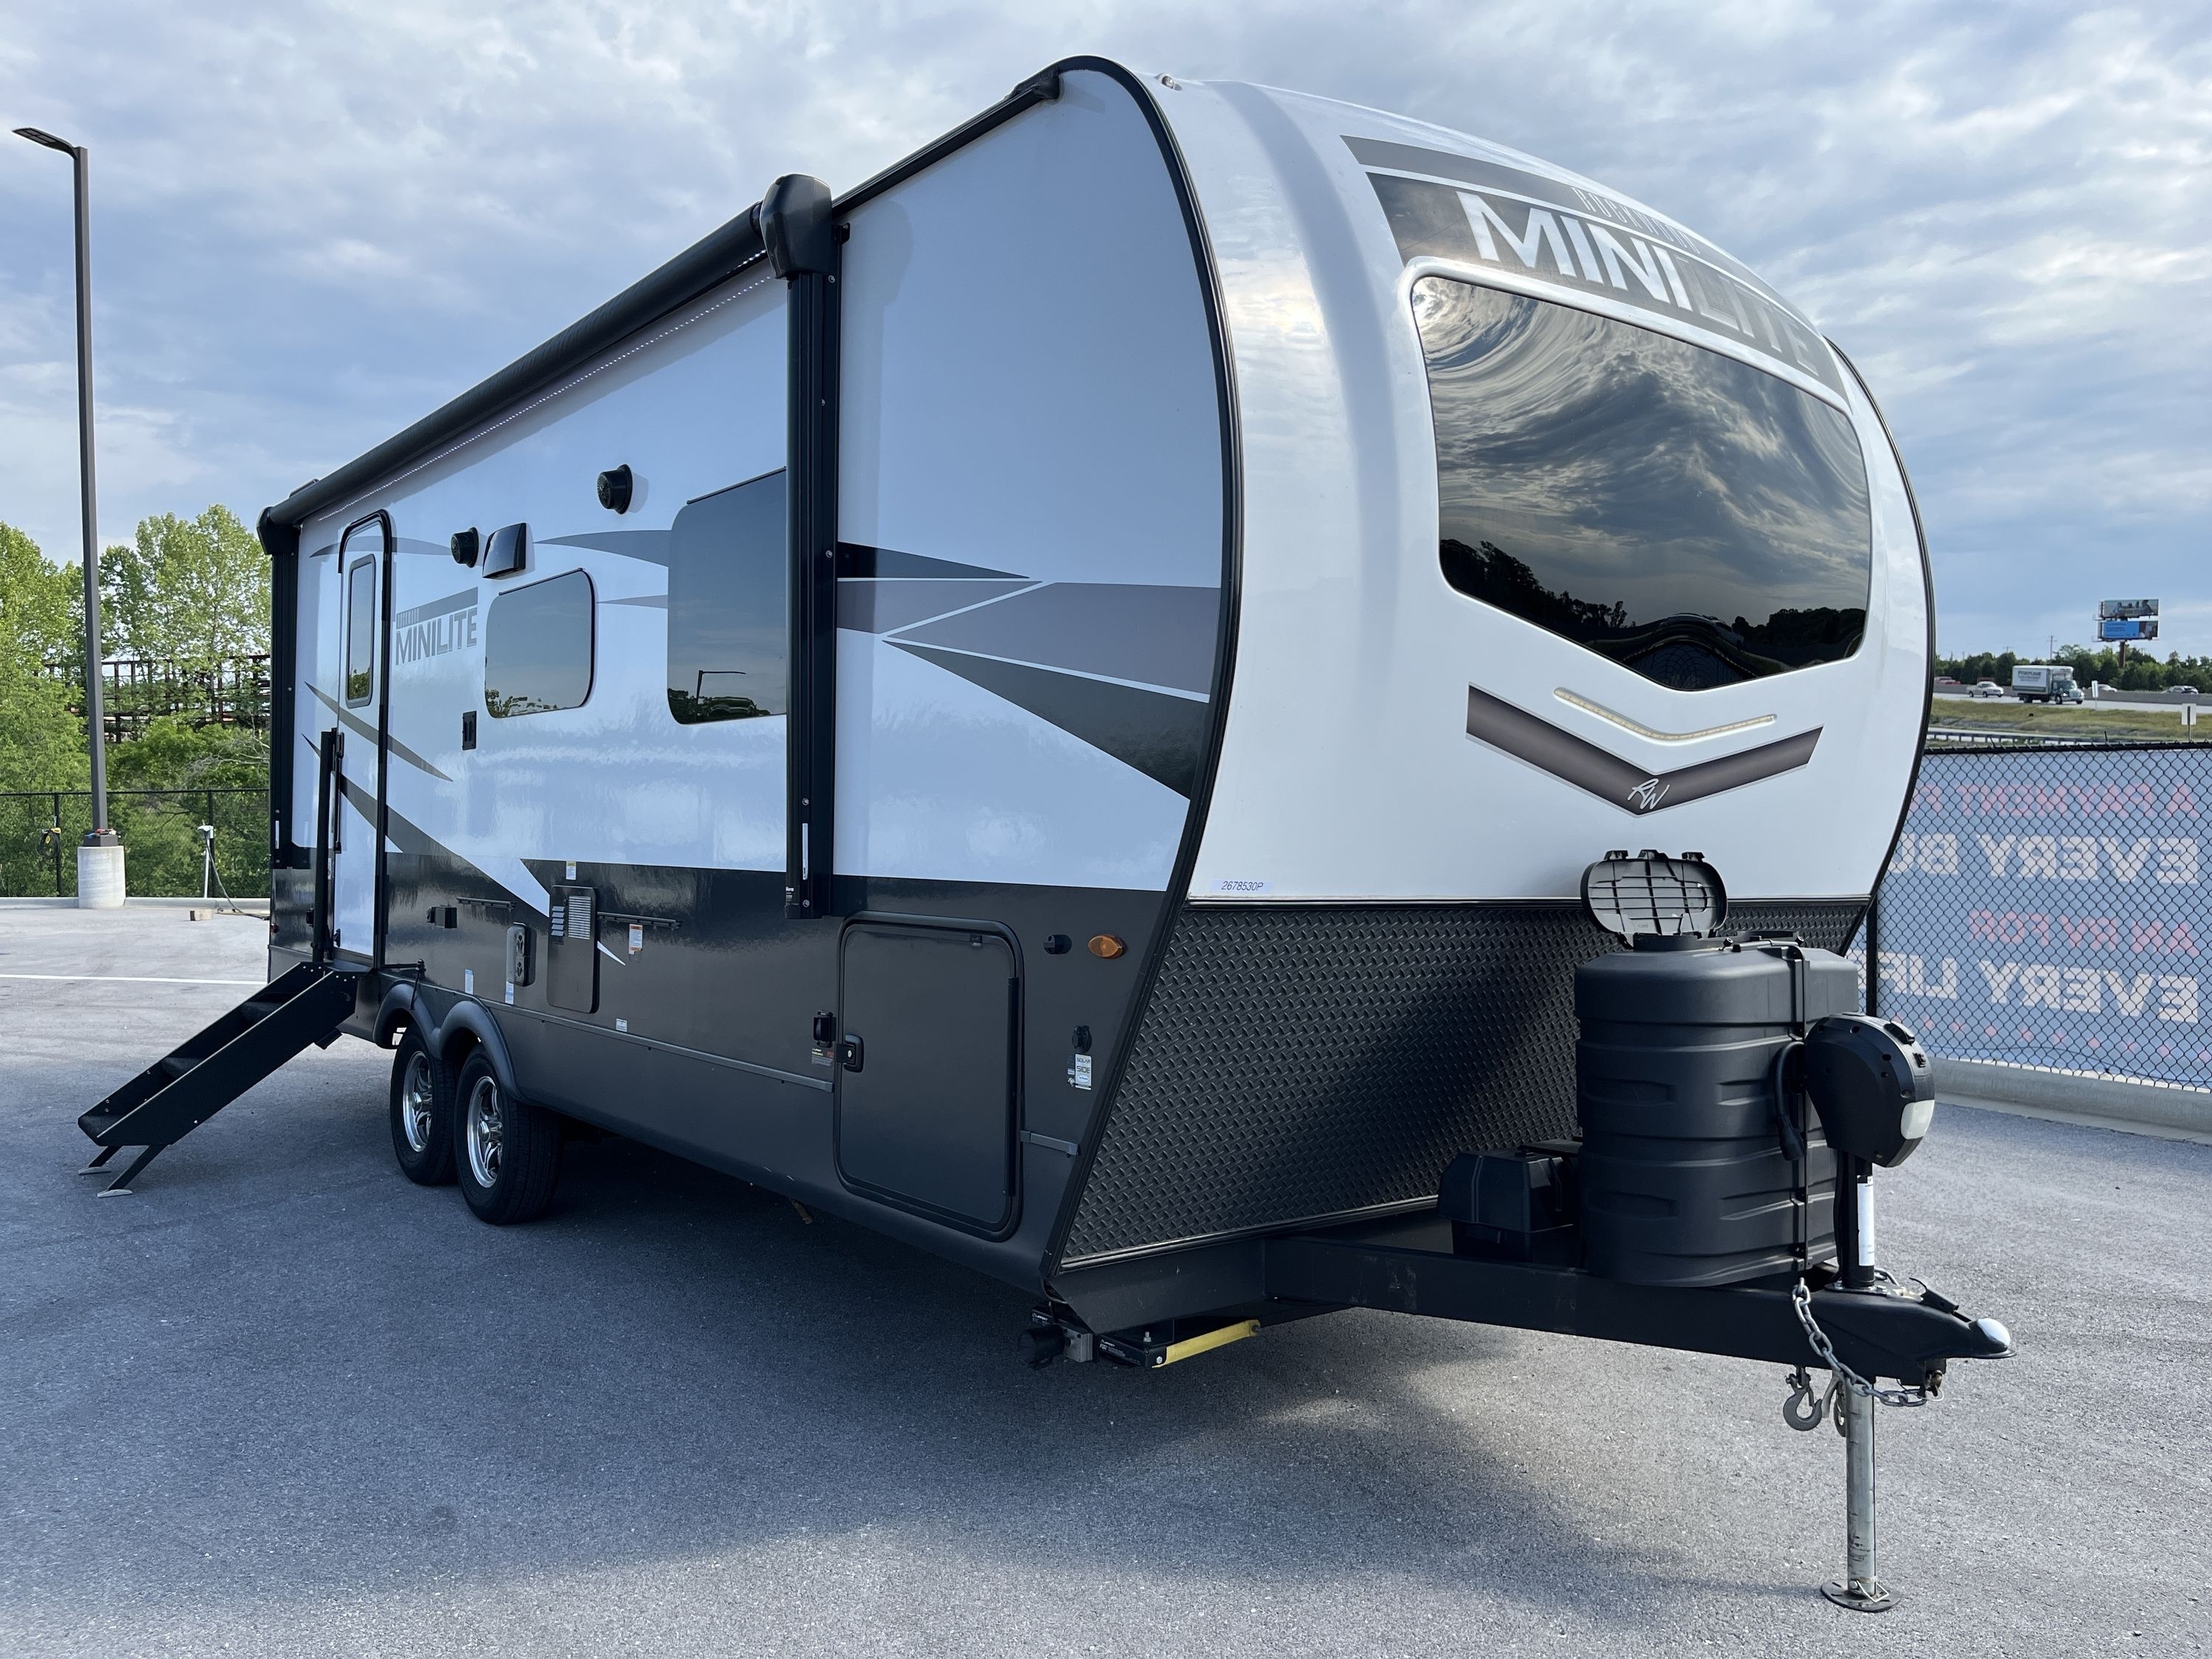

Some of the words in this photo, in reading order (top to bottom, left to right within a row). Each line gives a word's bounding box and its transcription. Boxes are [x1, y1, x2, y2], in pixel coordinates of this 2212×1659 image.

[1571, 187, 1700, 254] ROCKWOOD
[396, 607, 477, 666] MINILITE
[1221, 880, 1264, 891] 2678530P
